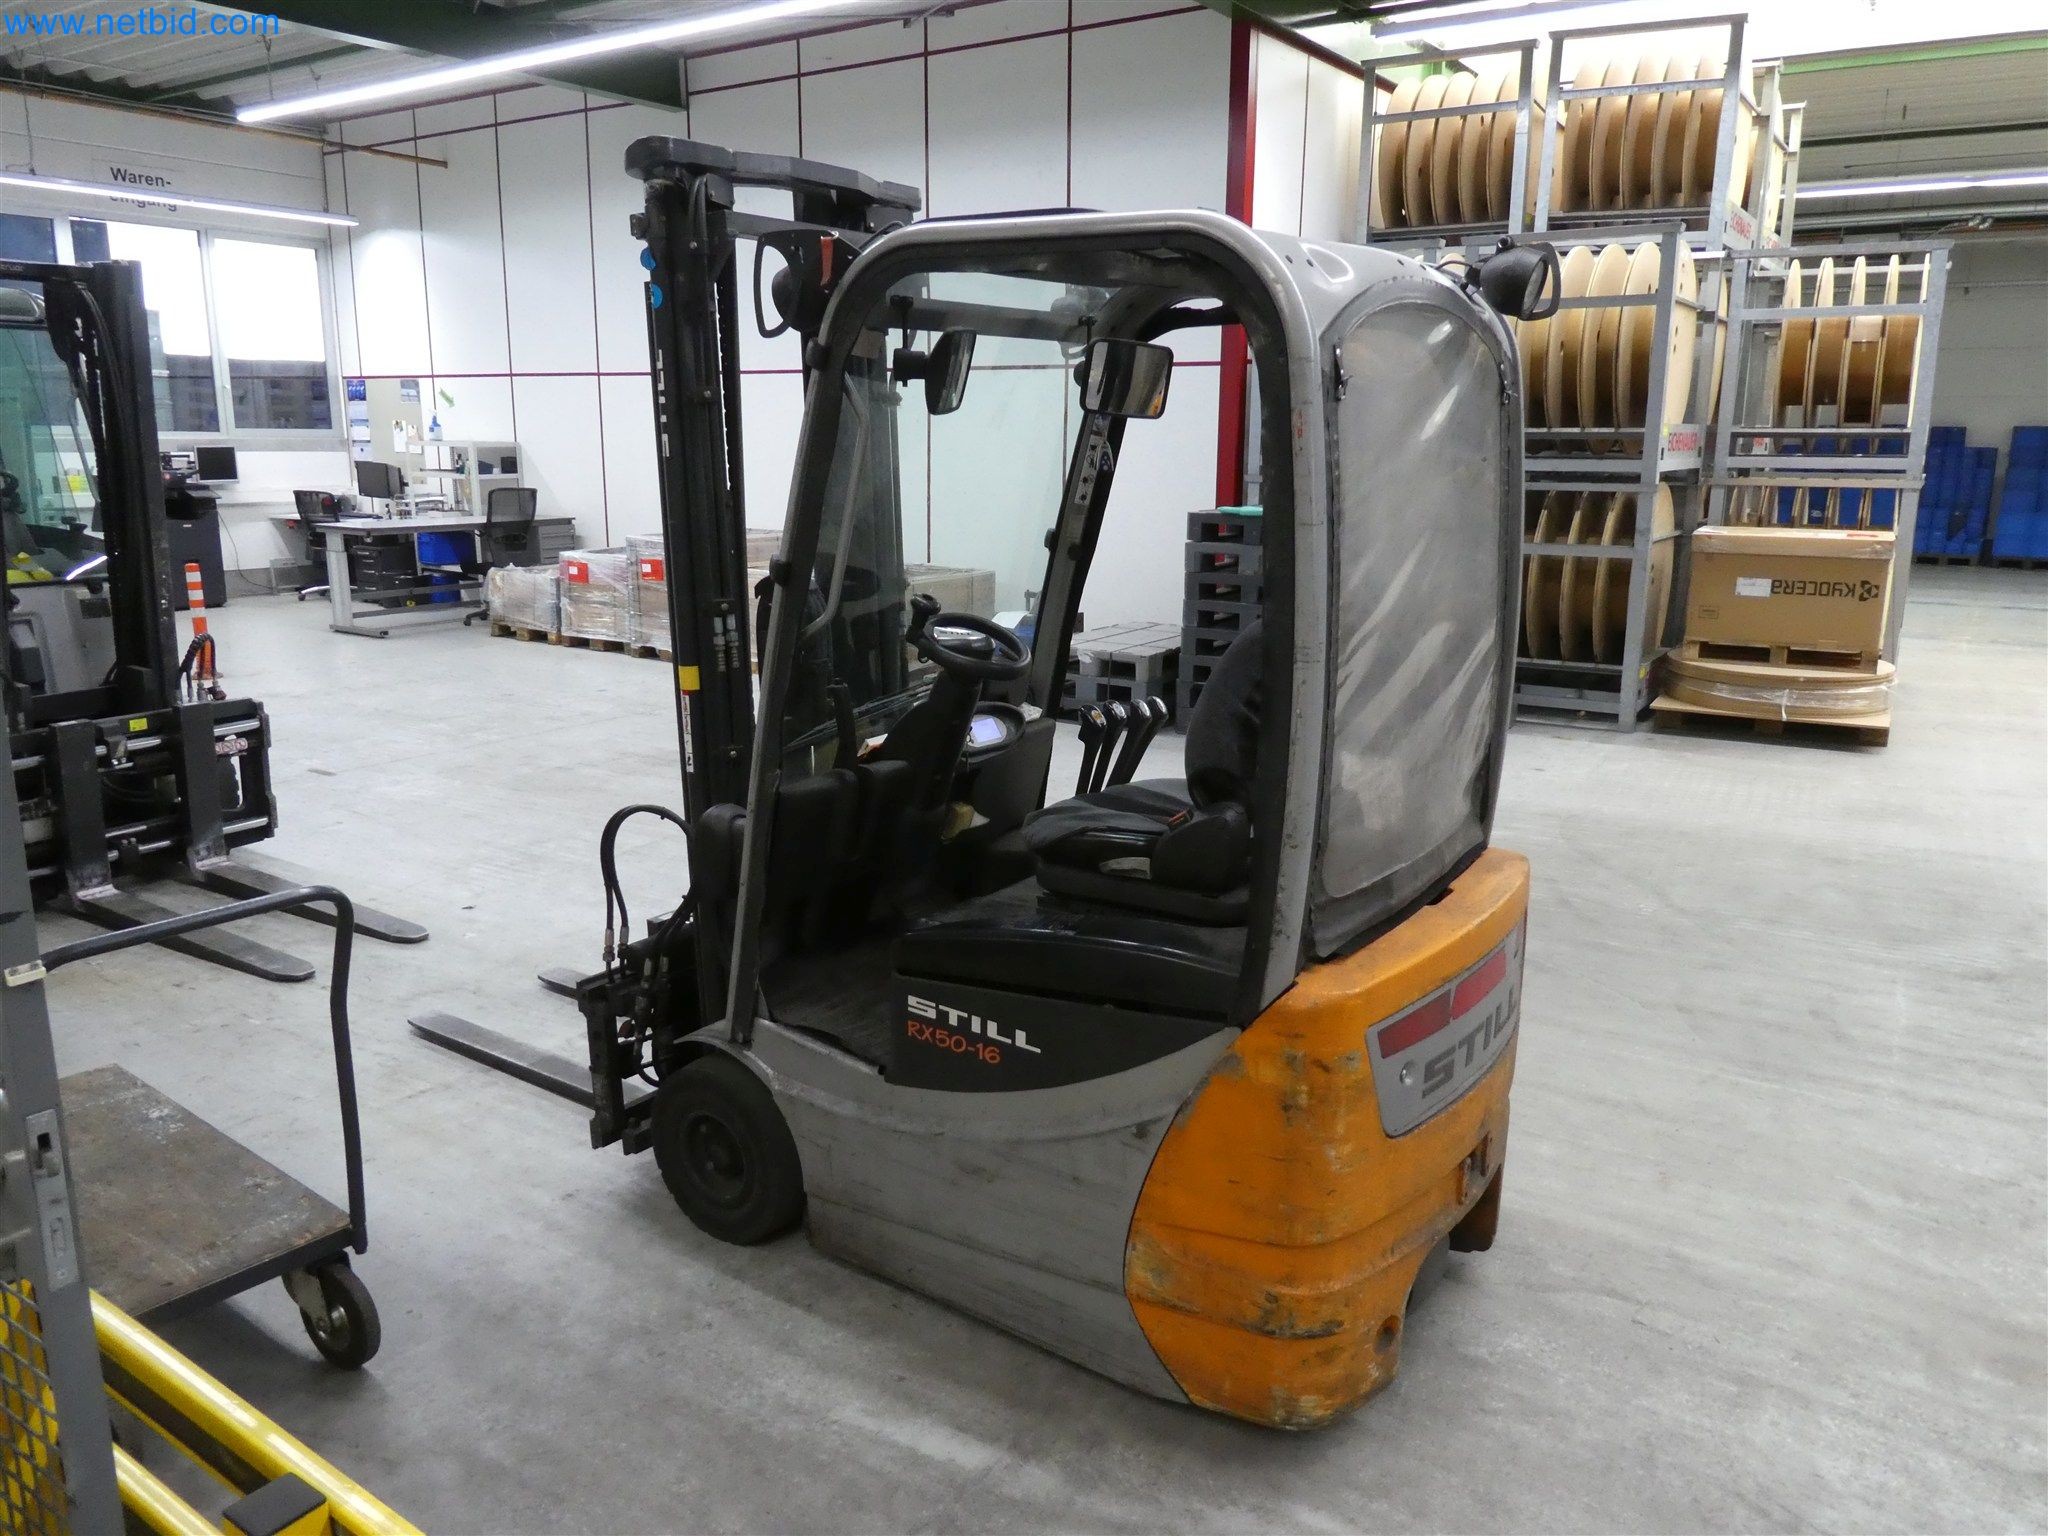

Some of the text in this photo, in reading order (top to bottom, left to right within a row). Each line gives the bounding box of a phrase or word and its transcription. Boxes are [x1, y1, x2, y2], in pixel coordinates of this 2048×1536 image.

[110, 167, 171, 187] Waren-
[1771, 579, 1856, 598] KYOCERA
[908, 995, 1041, 1053] STILL
[907, 1020, 1001, 1064] RX50-16
